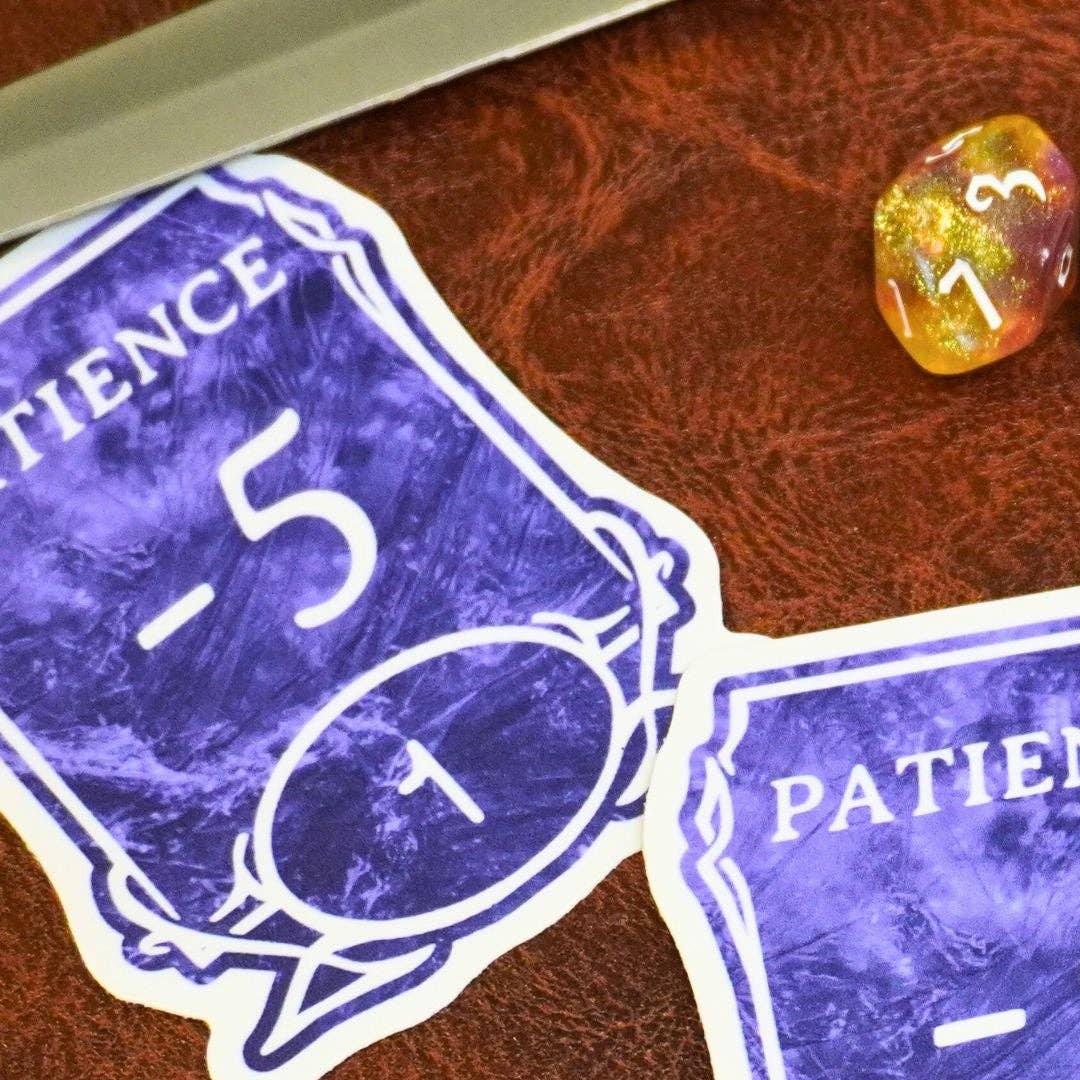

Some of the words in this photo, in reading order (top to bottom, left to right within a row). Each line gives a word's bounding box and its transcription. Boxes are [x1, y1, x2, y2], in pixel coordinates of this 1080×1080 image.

[966, 169, 1046, 213] 3
[0, 236, 287, 480] TIENCE
[397, 739, 485, 824] 1
